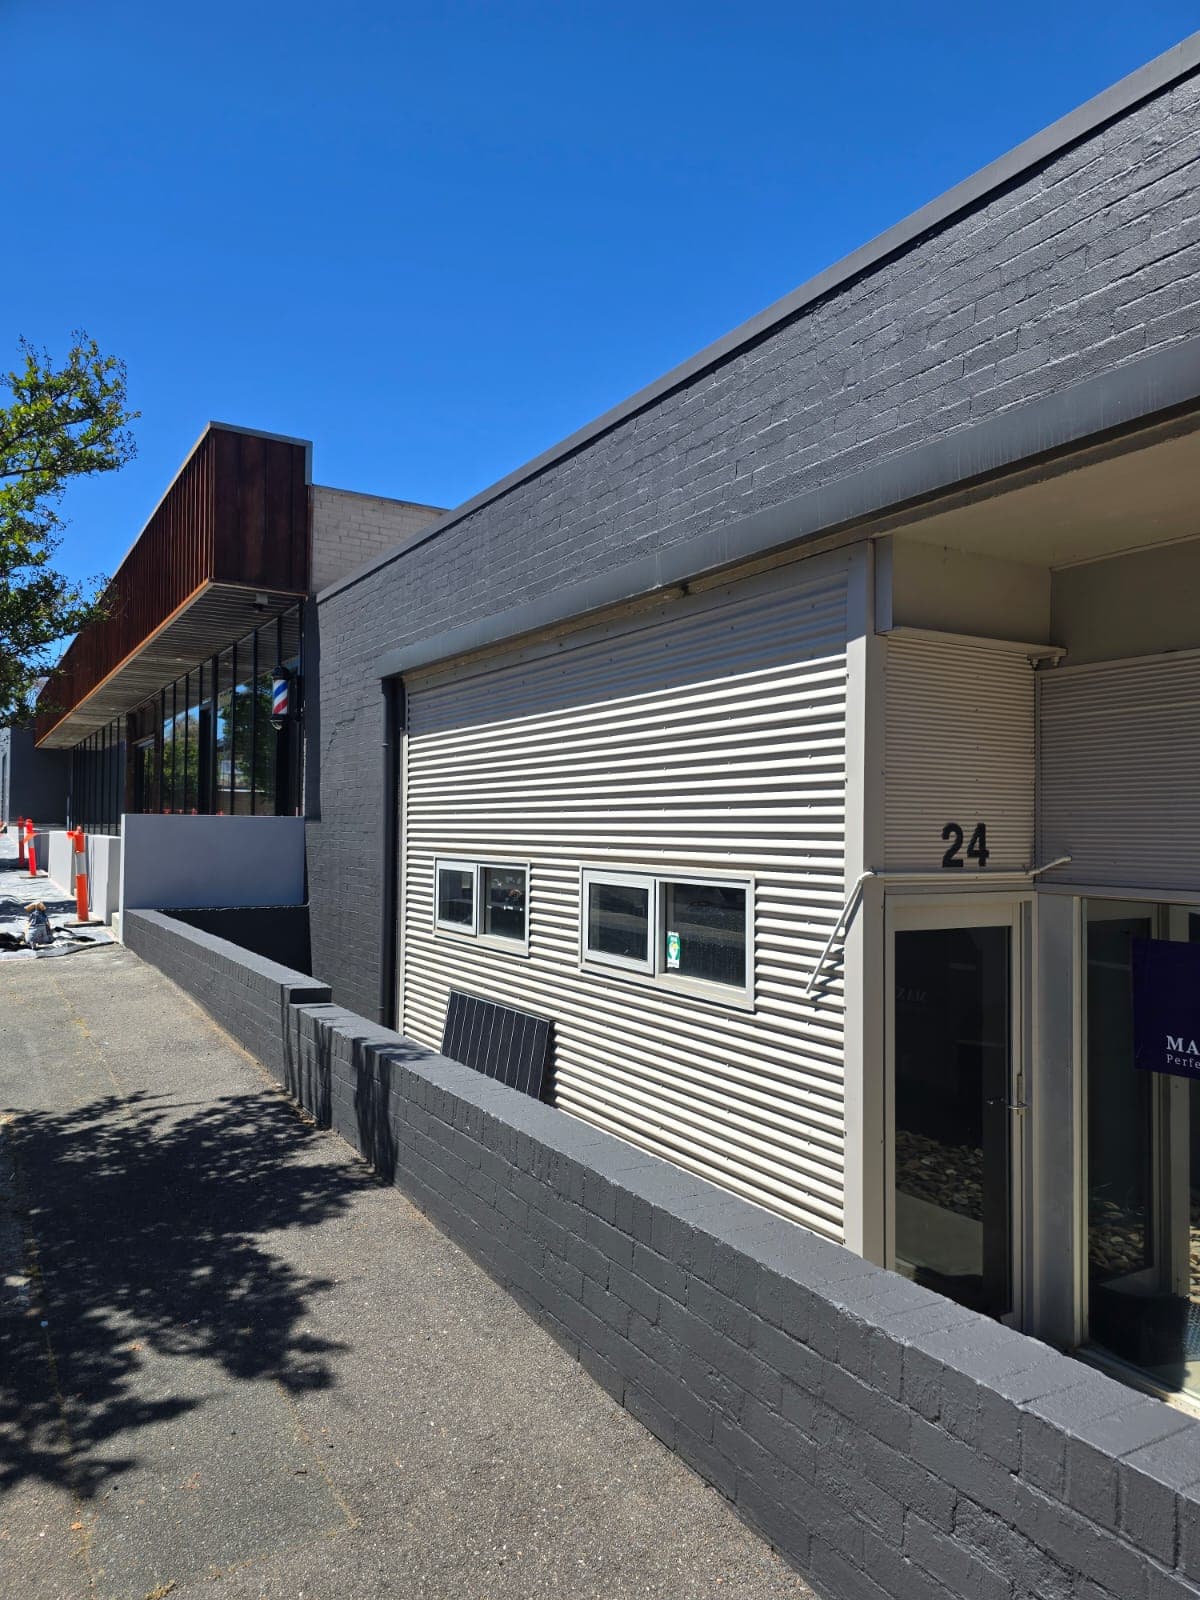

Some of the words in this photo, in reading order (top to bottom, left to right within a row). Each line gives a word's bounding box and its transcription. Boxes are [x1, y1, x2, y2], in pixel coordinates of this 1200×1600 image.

[942, 822, 990, 868] 24
[1166, 1034, 1200, 1056] MA
[1167, 1053, 1200, 1069] Perfe
